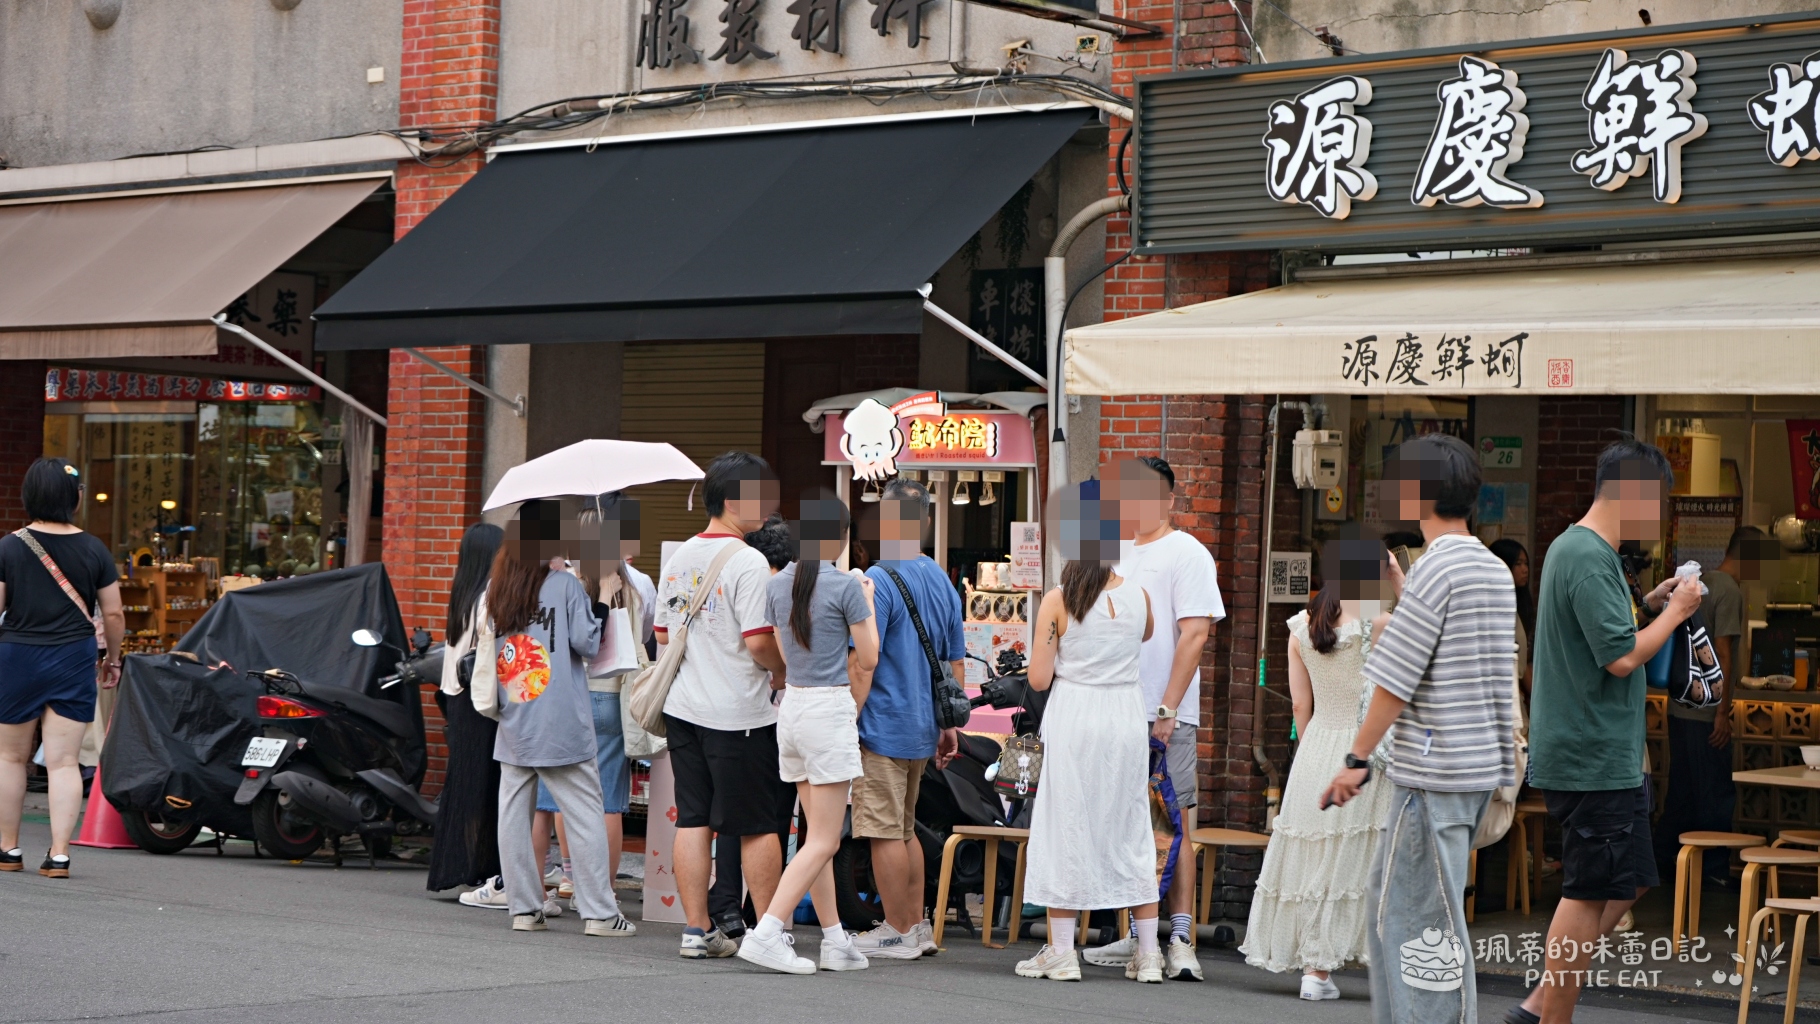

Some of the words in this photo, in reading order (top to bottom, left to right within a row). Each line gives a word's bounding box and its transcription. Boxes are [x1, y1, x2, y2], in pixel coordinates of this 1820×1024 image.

[1341, 332, 1530, 389] 源慶鮮蚵
[969, 452, 986, 460] squid
[1497, 450, 1514, 464] 26
[891, 573, 914, 609] ARMOUR
[912, 613, 927, 643] UNDER
[923, 640, 941, 678] ARMOUR
[879, 936, 903, 947] HOKA
